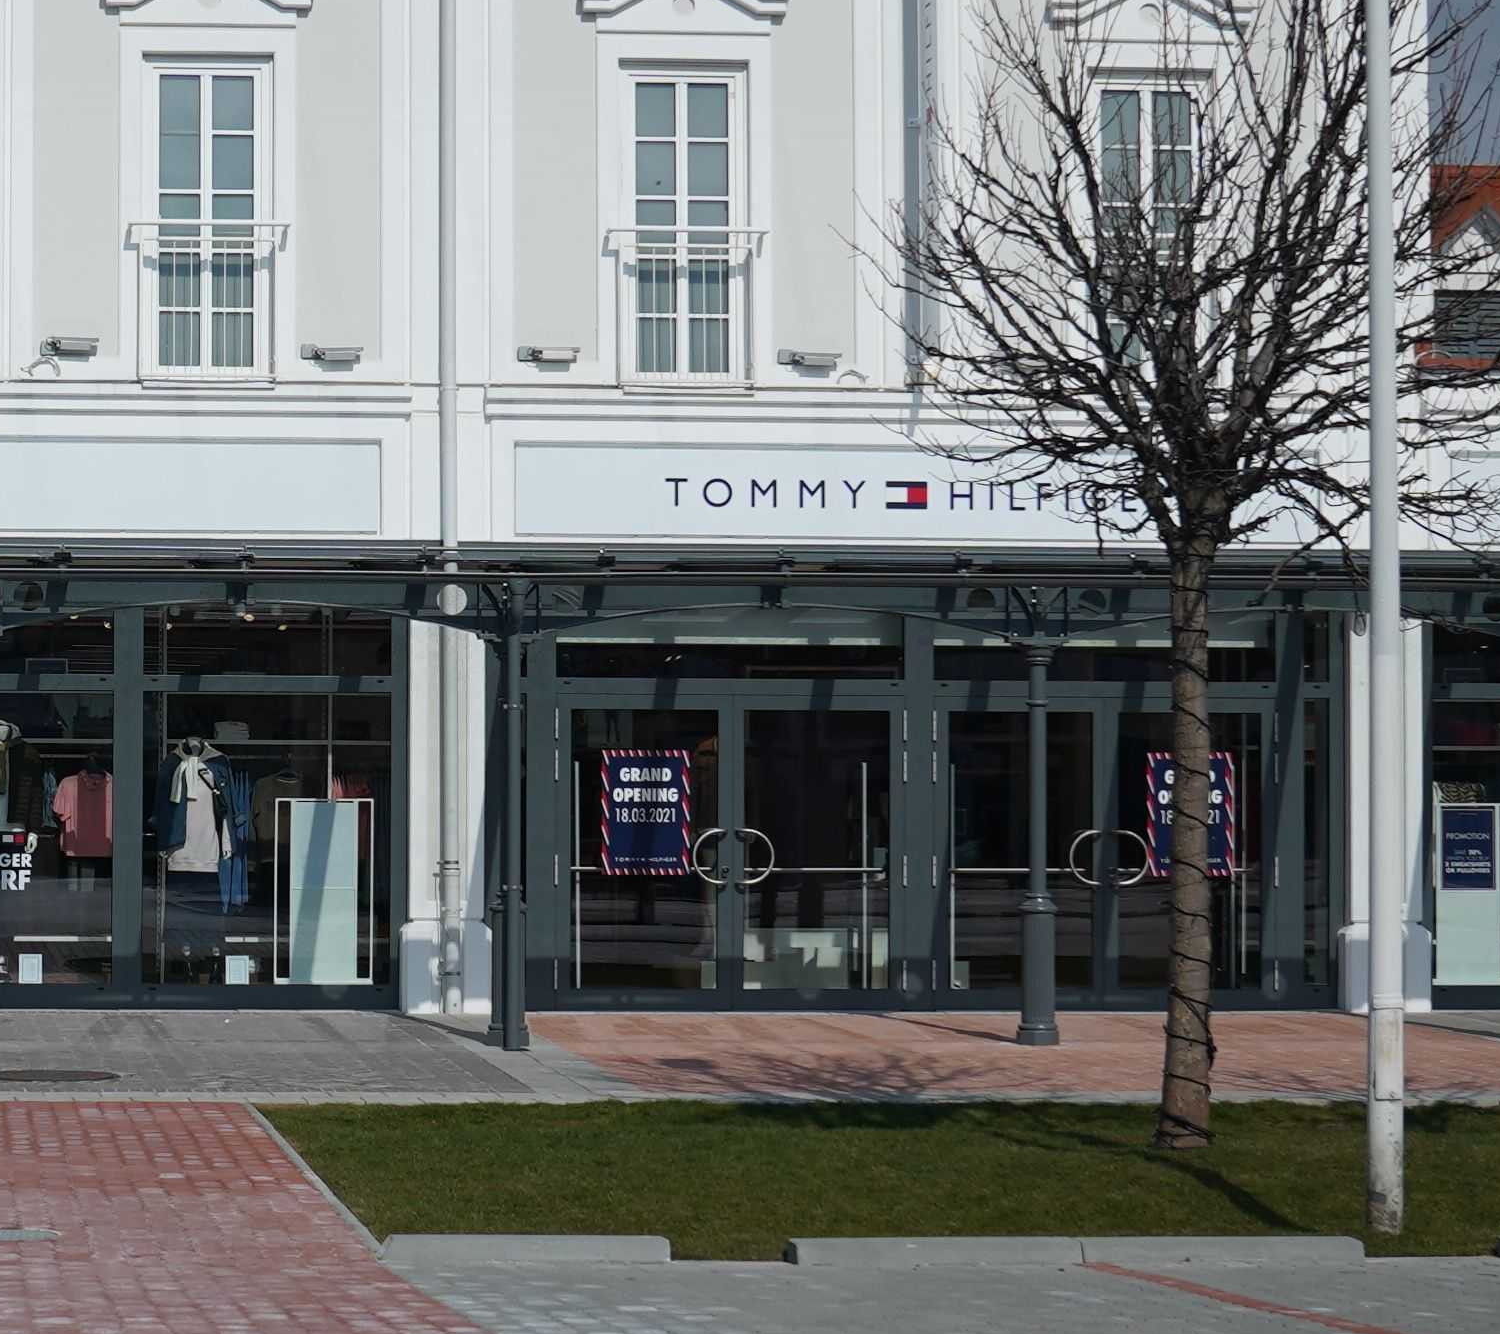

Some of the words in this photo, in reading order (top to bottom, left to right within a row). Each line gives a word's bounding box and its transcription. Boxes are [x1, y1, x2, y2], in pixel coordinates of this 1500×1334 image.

[665, 477, 867, 508] TOMMY
[949, 480, 1138, 513] HILFIGE
[619, 767, 672, 782] GRAND
[612, 787, 679, 803] OPENING
[615, 808, 676, 823] 18.03.2021
